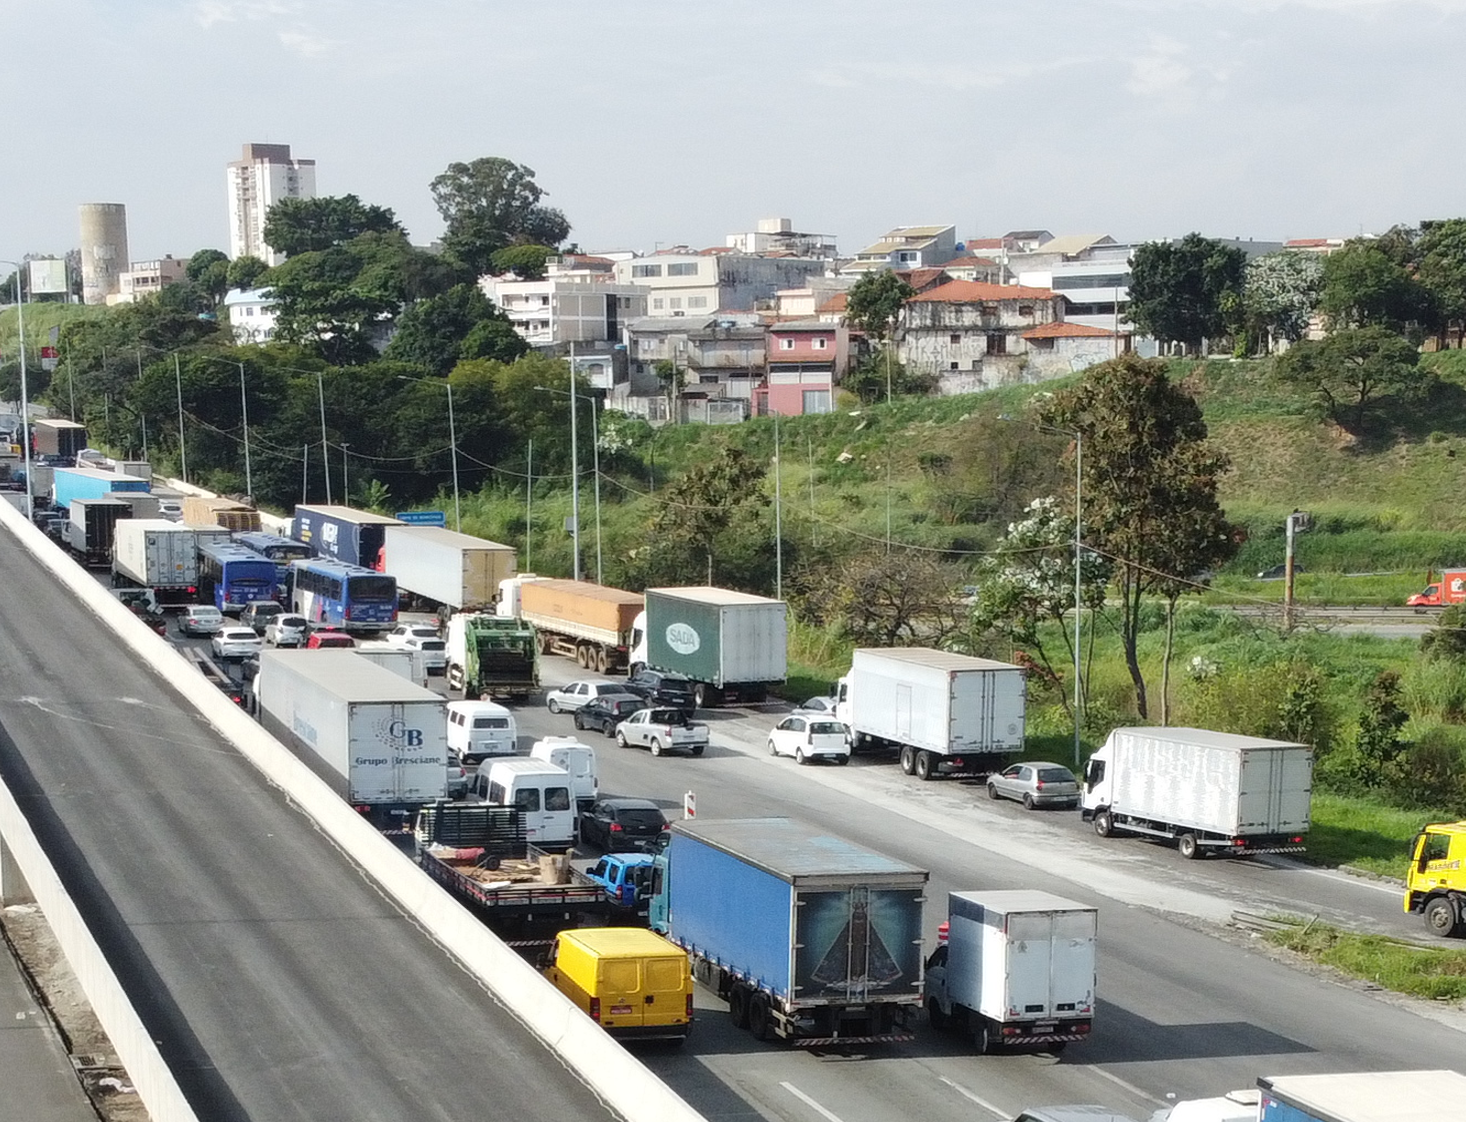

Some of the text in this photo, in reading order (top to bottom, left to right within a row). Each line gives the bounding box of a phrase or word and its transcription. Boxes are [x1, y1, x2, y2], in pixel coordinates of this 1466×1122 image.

[669, 628, 695, 647] SADA
[389, 721, 423, 747] GB
[355, 756, 388, 766] Grupo
